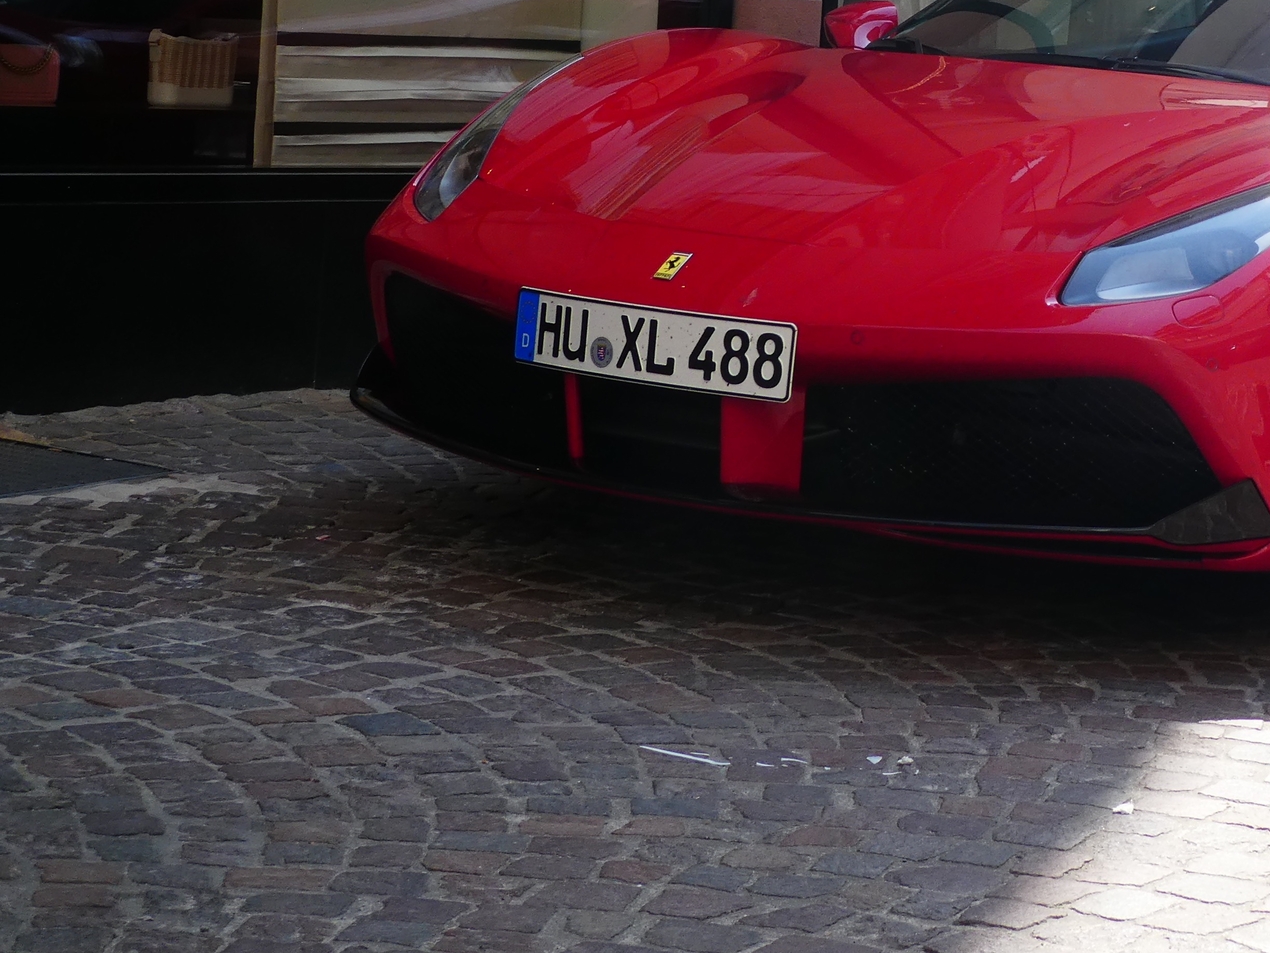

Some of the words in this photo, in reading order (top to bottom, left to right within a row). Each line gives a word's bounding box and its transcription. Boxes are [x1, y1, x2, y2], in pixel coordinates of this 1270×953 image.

[521, 333, 530, 348] D
[537, 302, 589, 362] HU
[616, 314, 675, 376] XL
[688, 326, 784, 389] 488
